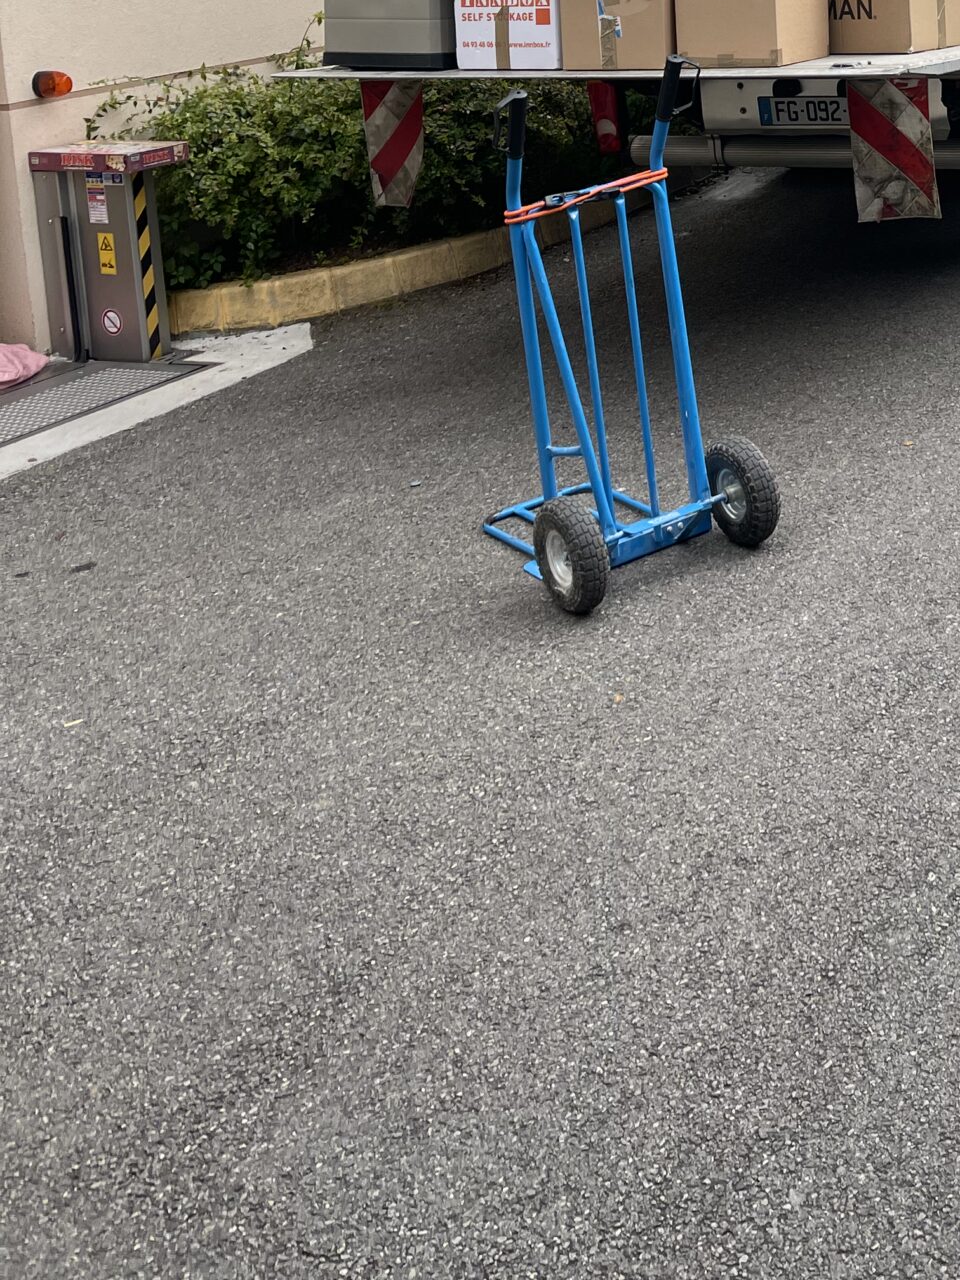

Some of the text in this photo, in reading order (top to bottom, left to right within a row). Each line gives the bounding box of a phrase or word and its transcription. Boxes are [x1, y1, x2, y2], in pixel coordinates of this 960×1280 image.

[461, 12, 484, 21] SELF
[60, 153, 95, 167] RISK
[142, 150, 170, 164] RISK
